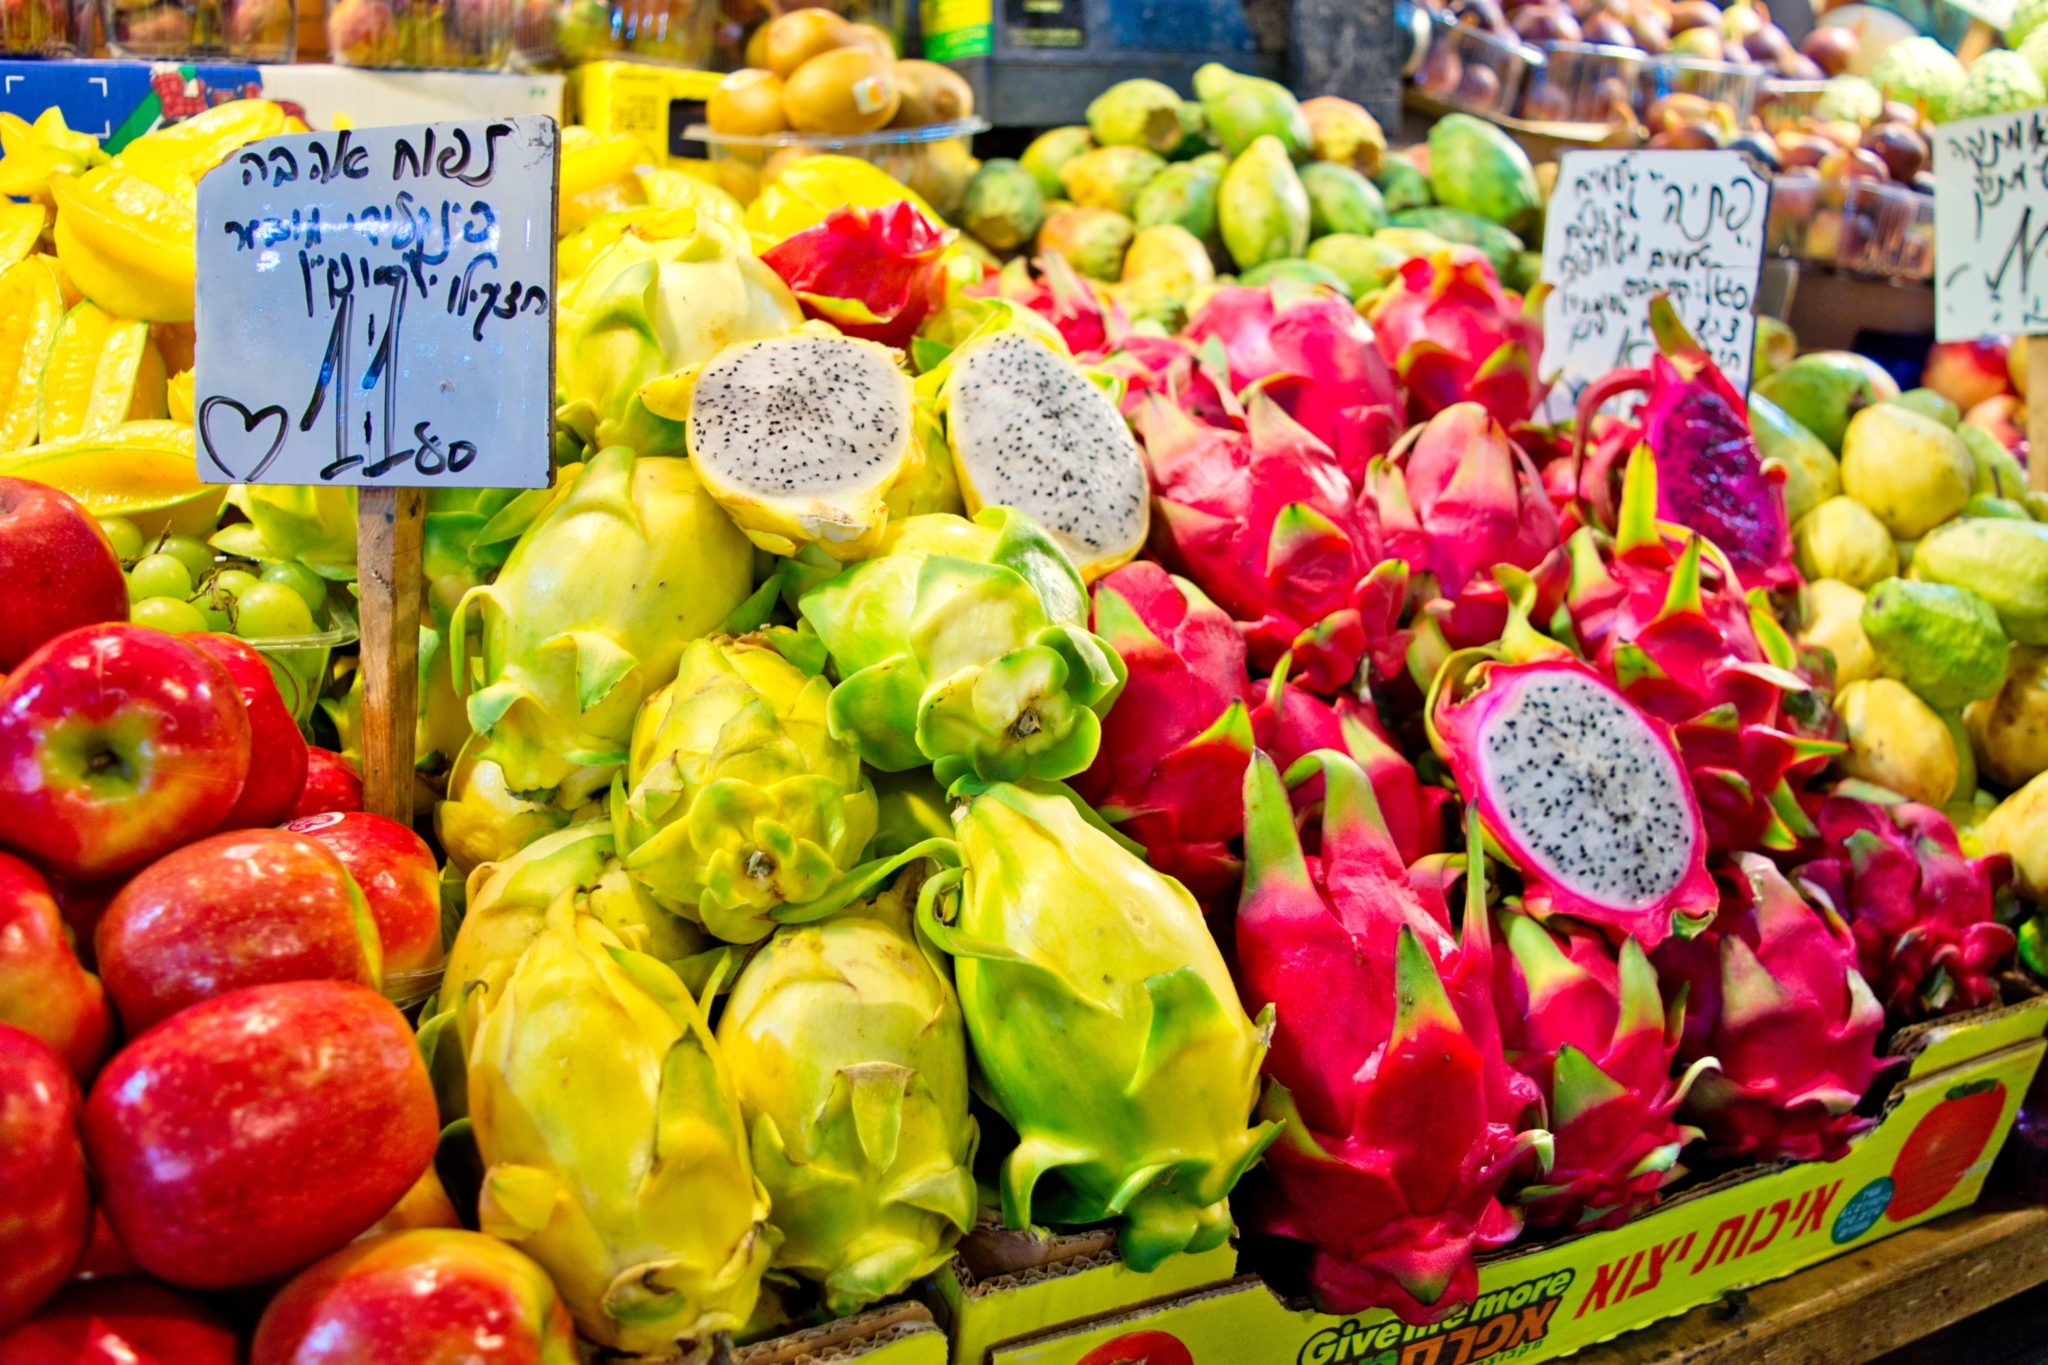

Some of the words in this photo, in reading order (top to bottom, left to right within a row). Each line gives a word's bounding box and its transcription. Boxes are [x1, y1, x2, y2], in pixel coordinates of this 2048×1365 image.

[240, 129, 369, 187] אהבה
[1690, 1178, 1844, 1276] איכות
[1299, 1320, 1401, 1365] Give
[1469, 1270, 1573, 1322] more
[1572, 1230, 1698, 1320] יצוא
